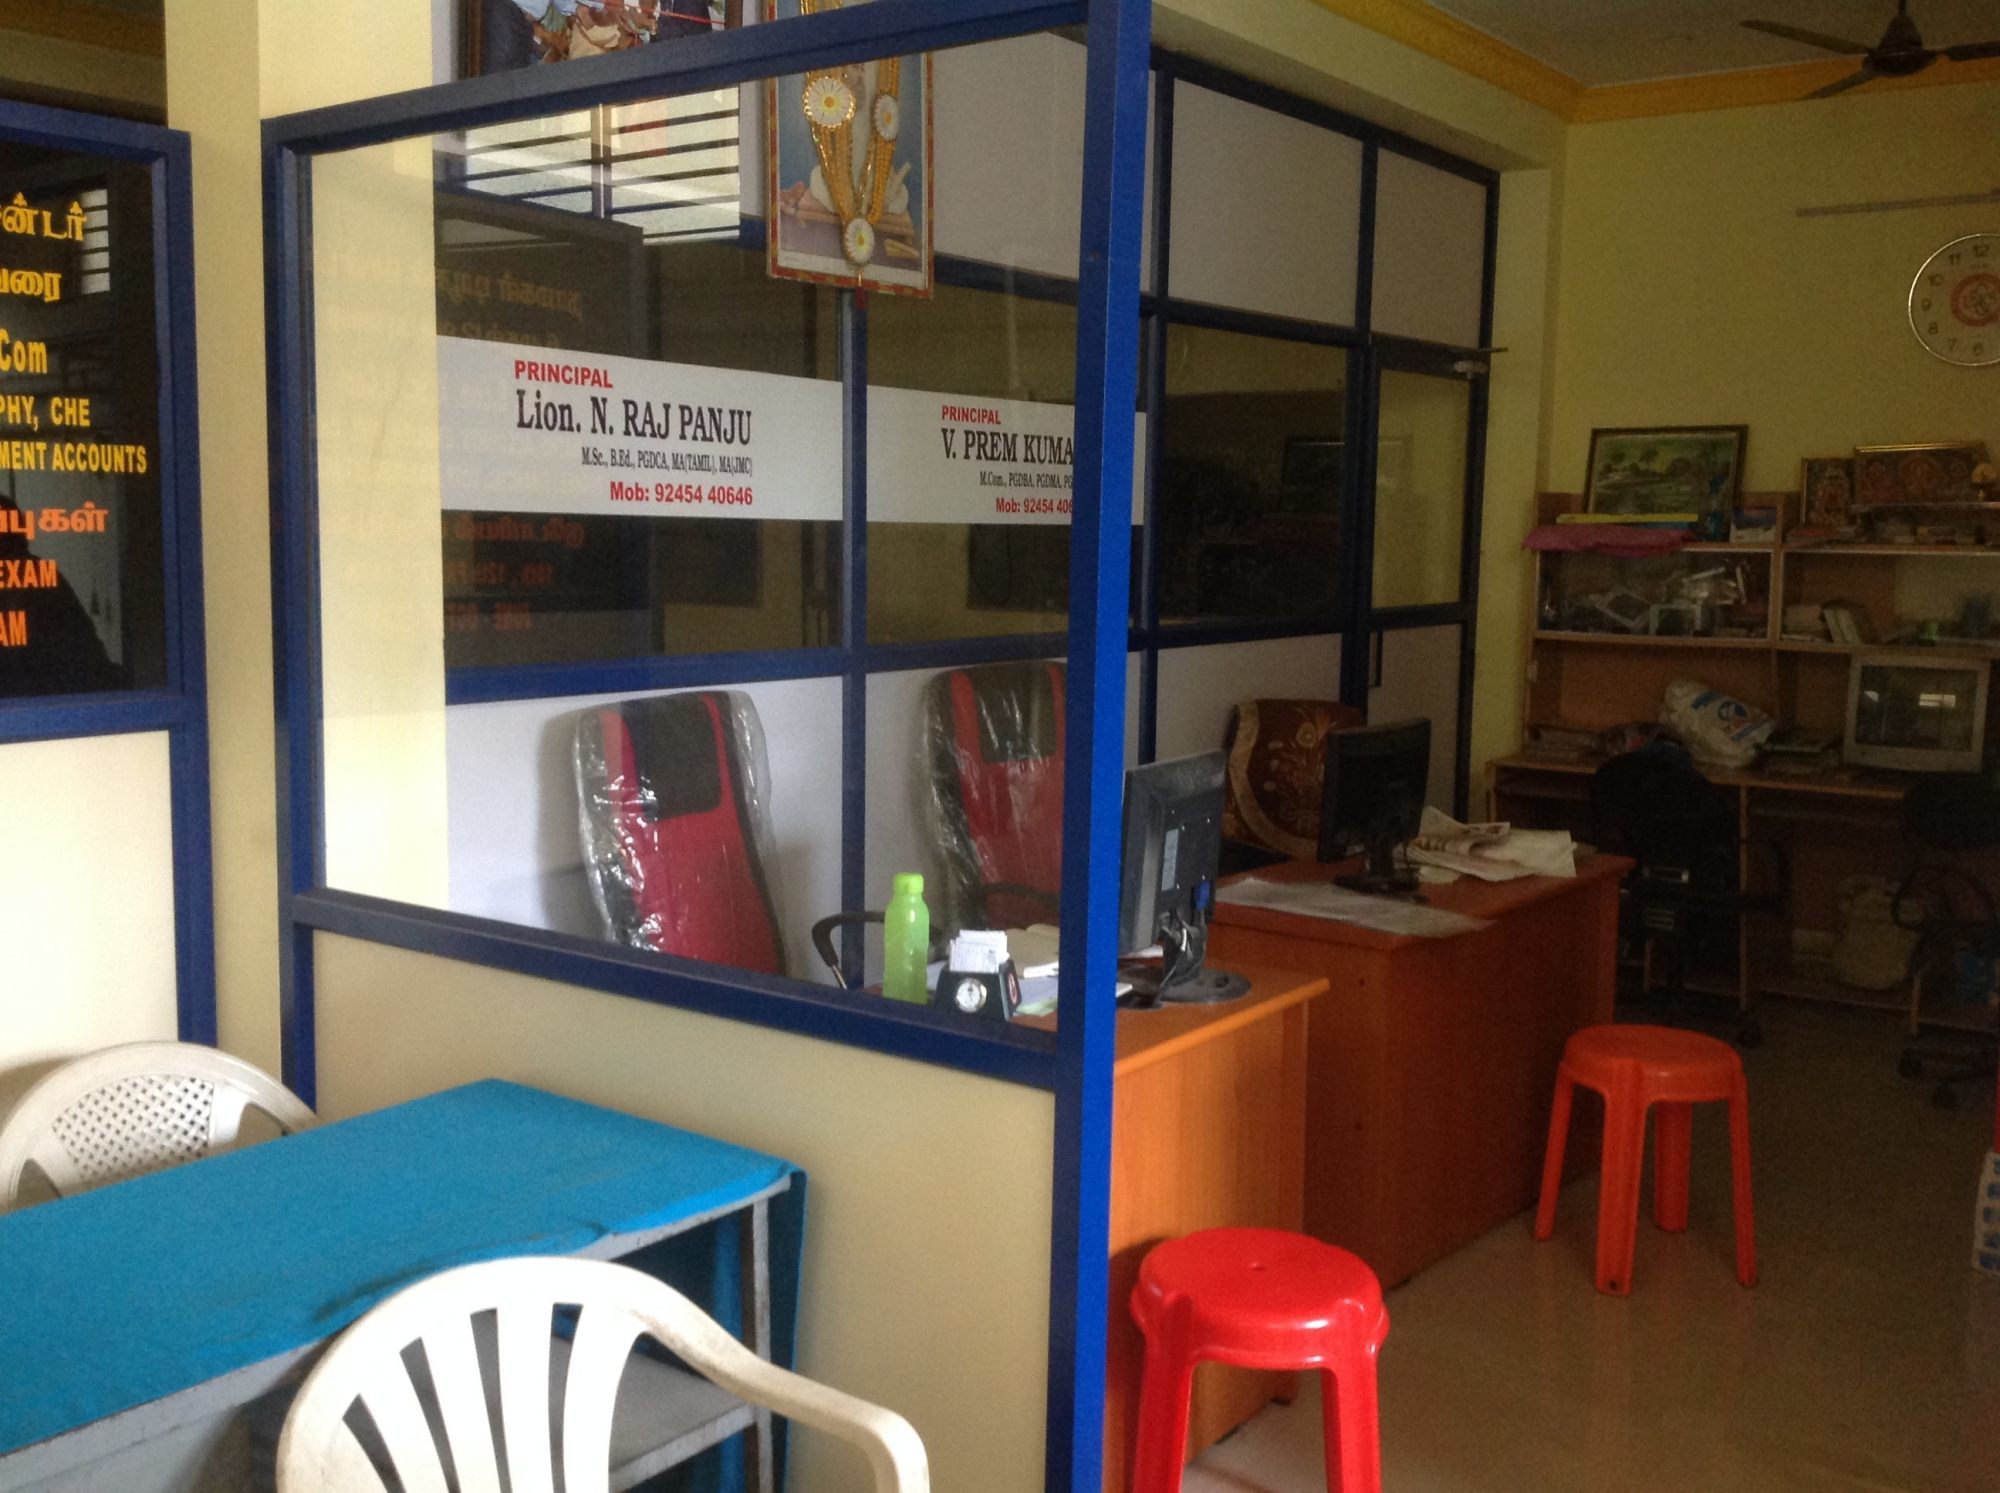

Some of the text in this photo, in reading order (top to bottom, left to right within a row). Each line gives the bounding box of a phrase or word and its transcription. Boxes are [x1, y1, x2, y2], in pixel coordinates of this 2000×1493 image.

[0, 191, 87, 241] ன்டர்
[514, 359, 614, 389] PRINCIPAL
[50, 396, 91, 427] CHE
[516, 388, 752, 446] Lion. N. RAJ PANJU
[942, 405, 1002, 425] PRINCIPAL
[0, 440, 147, 474] MENT ACCOUNTS
[941, 428, 956, 459] V.
[963, 429, 1018, 462] PREM
[637, 450, 670, 472] PGDCA,
[610, 480, 753, 506] Mob: 92454 40646
[996, 497, 1021, 513] Mob:
[1023, 498, 1054, 514] 92454
